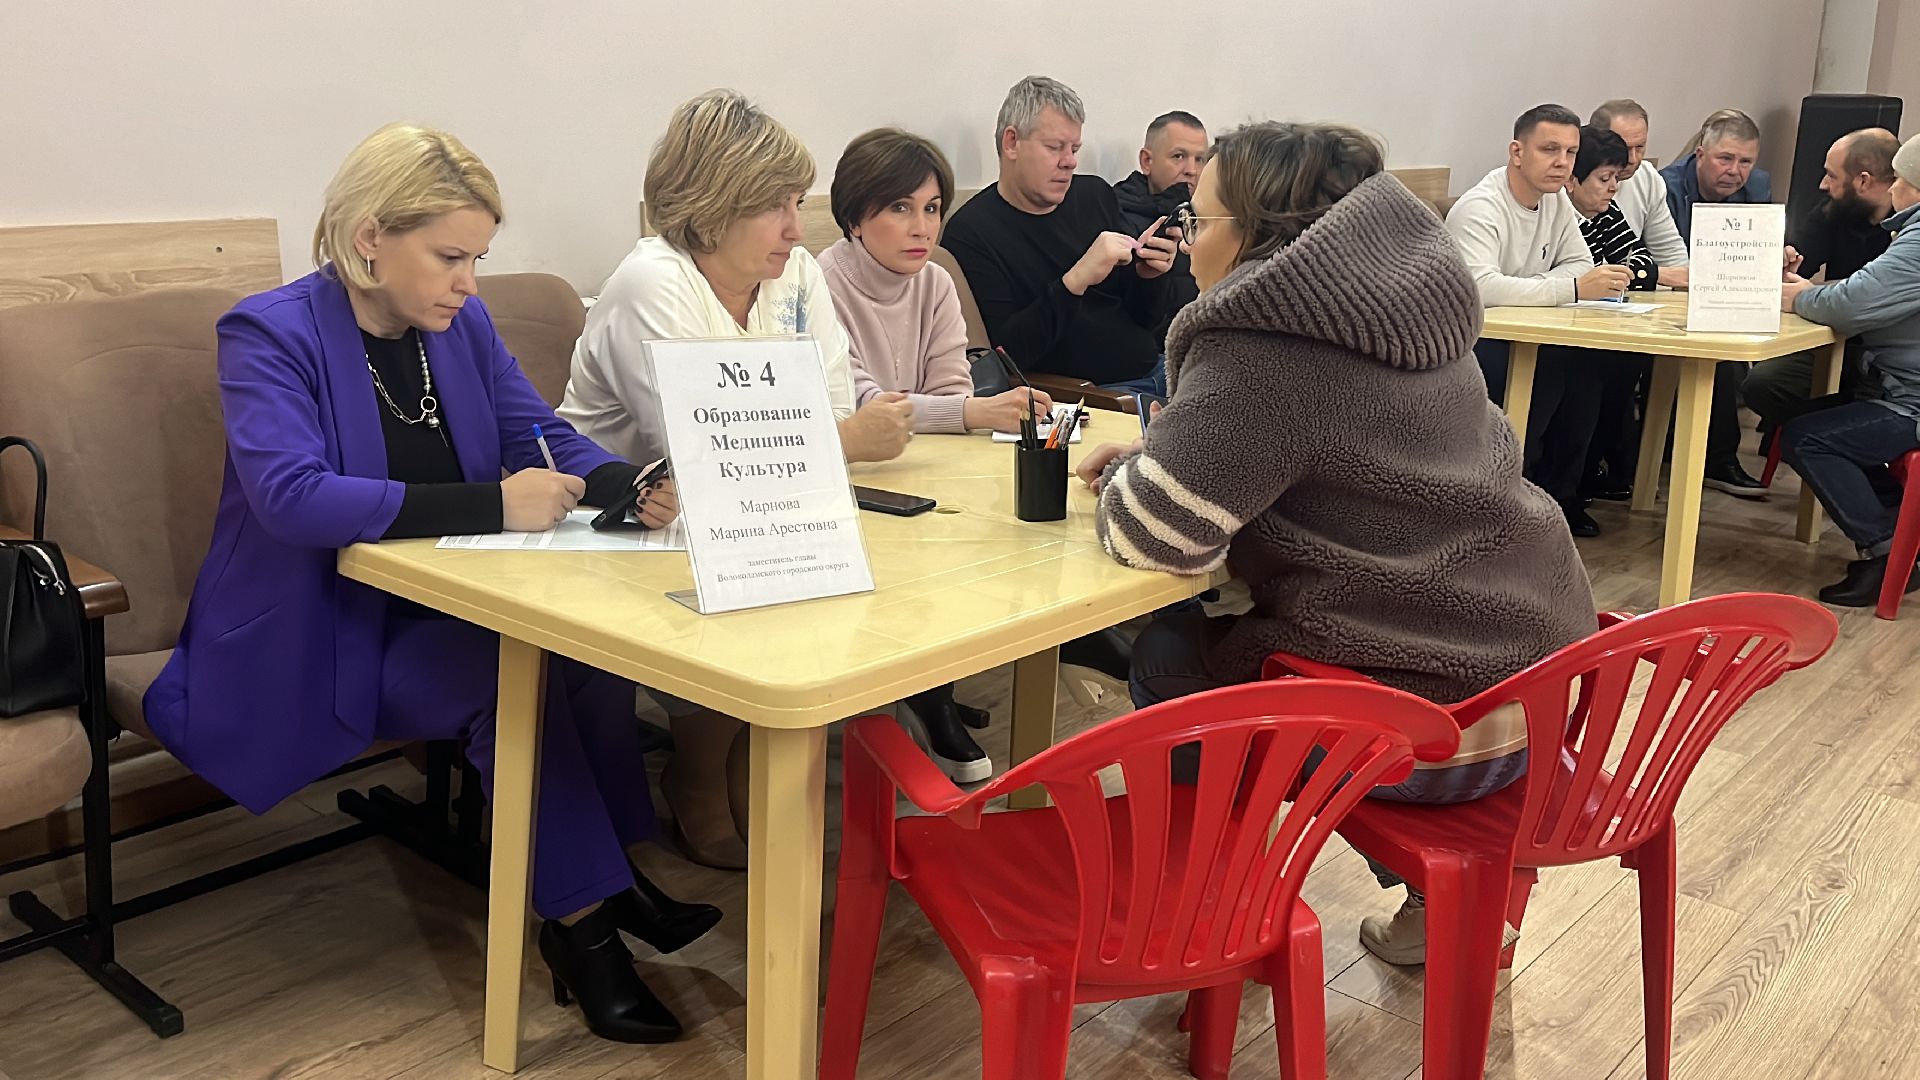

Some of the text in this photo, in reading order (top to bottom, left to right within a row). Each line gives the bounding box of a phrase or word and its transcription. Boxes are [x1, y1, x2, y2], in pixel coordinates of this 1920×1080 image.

[1722, 218, 1753, 231] № 1
[1696, 238, 1780, 249] Благоустройство
[1718, 252, 1755, 262] Дороги
[717, 361, 776, 388] № 4
[693, 406, 812, 427] Образование
[710, 433, 805, 452] Медицина
[719, 458, 807, 481] Культура
[740, 498, 801, 516] Марнова
[709, 519, 838, 543] Марина Арестовна
[747, 554, 817, 567] заместитель главы
[783, 565, 824, 576] городского
[825, 562, 850, 572] округа
